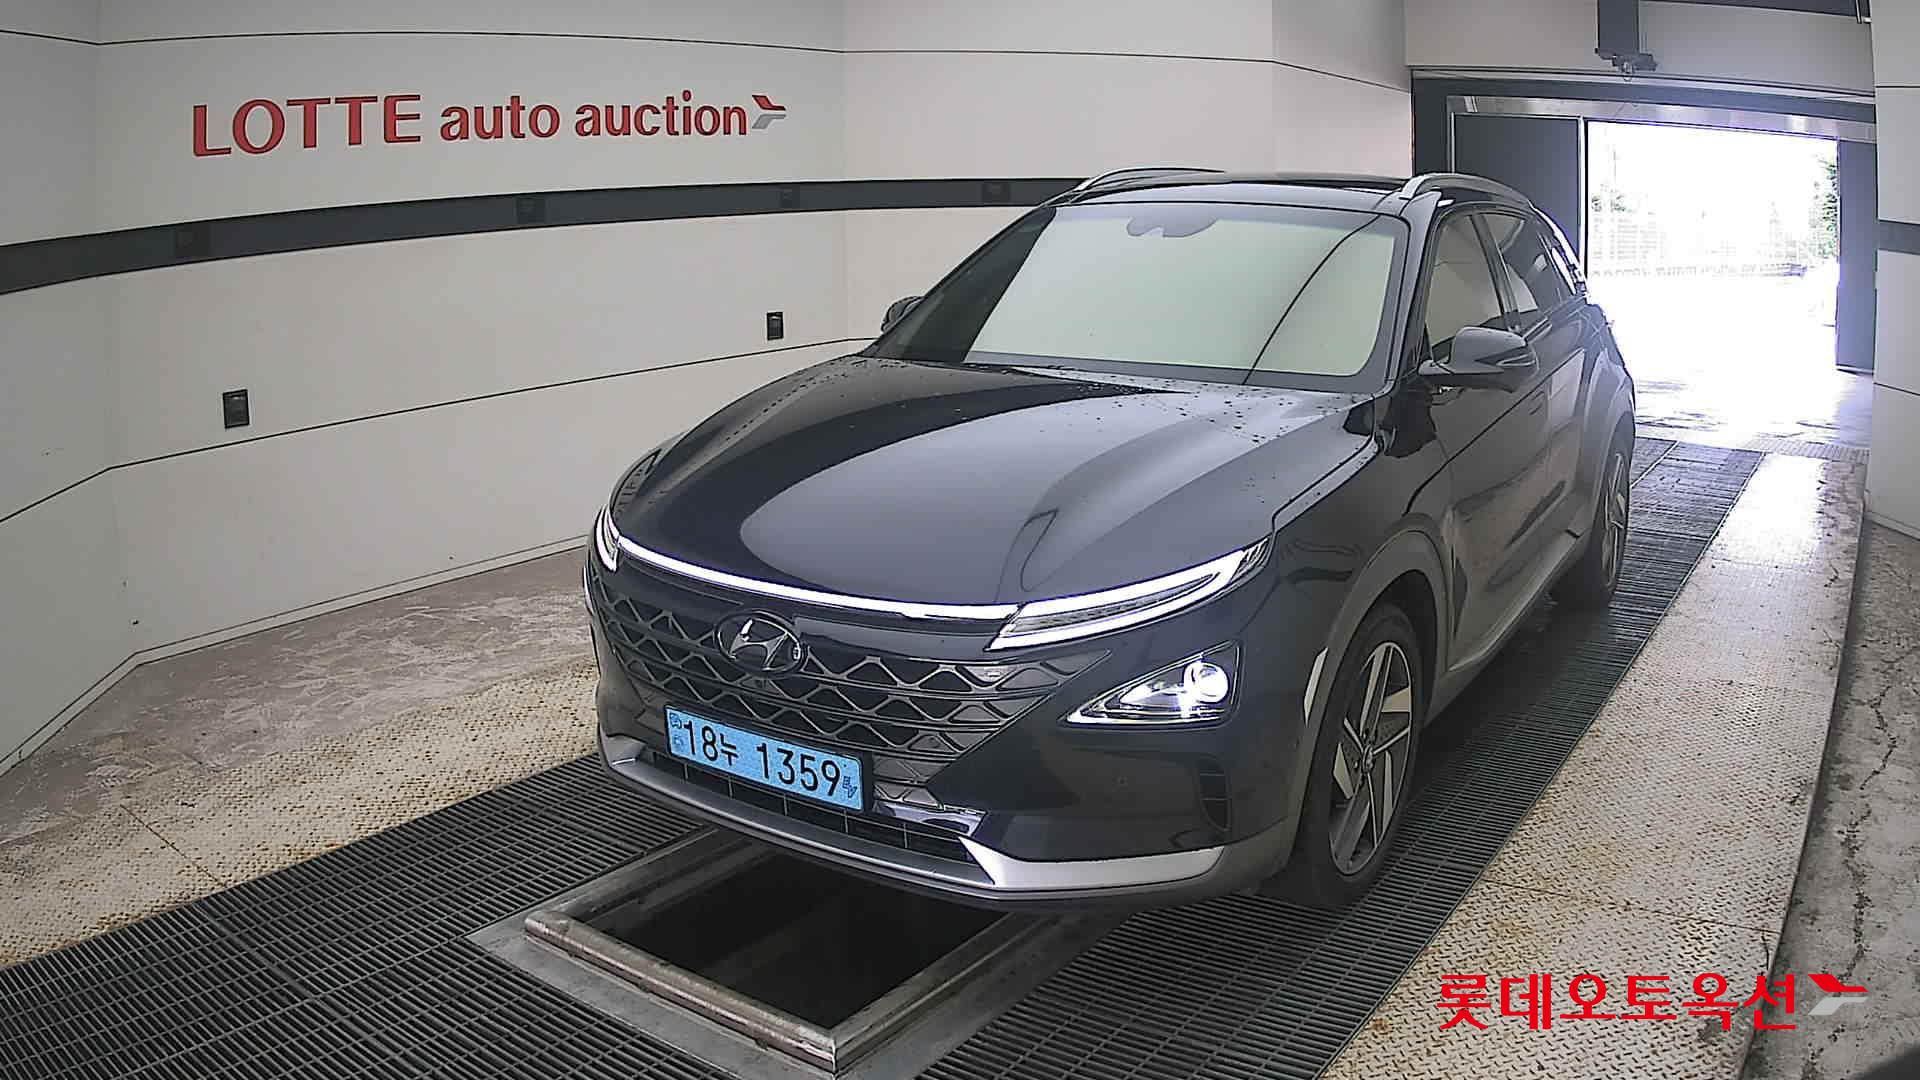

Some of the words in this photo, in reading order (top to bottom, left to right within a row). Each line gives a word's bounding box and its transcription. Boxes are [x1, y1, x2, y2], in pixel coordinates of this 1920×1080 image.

[193, 94, 421, 157] LOTTE
[439, 95, 560, 141] auto
[575, 89, 748, 137] auction
[683, 719, 739, 766] 18누
[756, 742, 841, 796] 1359
